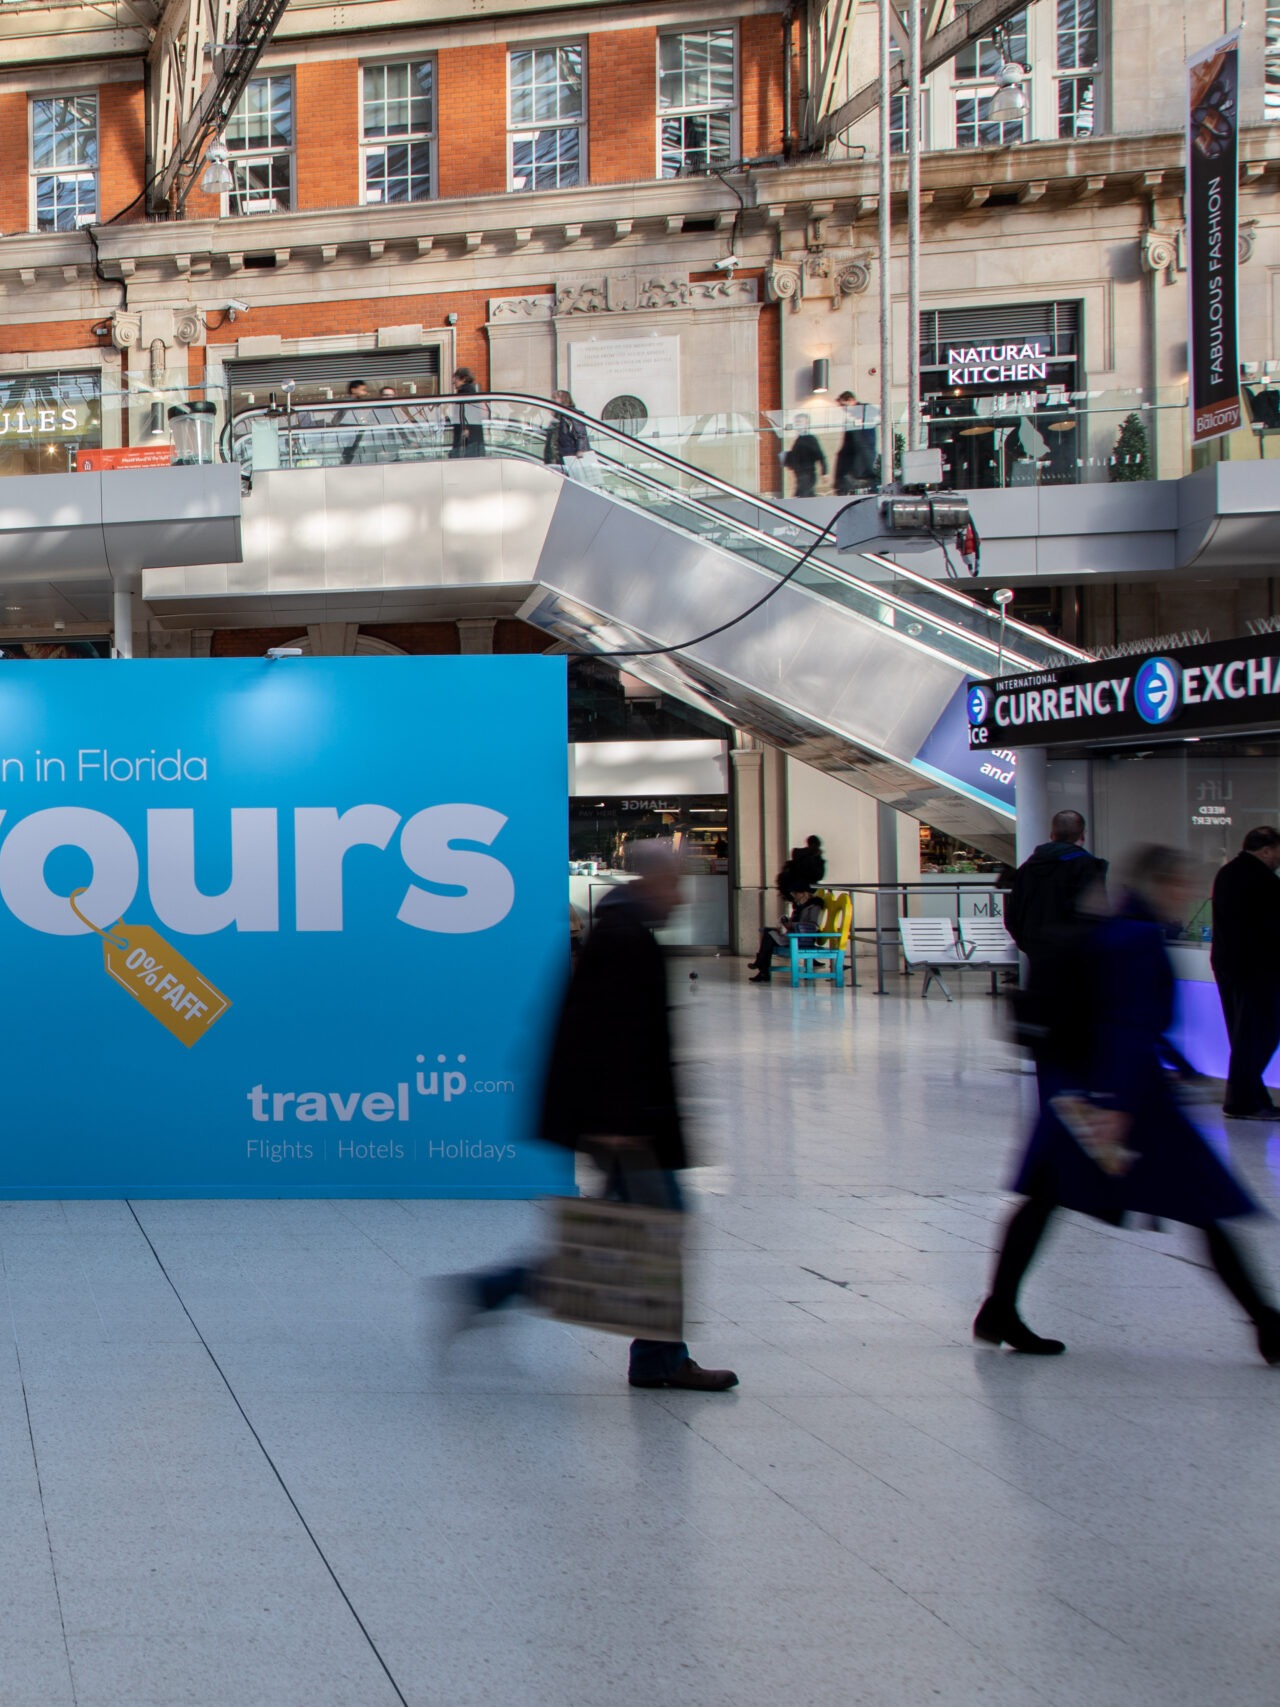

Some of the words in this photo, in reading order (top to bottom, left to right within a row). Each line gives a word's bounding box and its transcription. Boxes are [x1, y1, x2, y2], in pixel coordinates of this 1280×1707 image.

[1207, 176, 1222, 272] FASHION
[1209, 276, 1223, 385] FABULOUS
[948, 343, 1046, 364] NATURAL
[948, 363, 1046, 385] KITCHEN
[1196, 408, 1239, 432] Balcony
[996, 674, 1057, 692] INTERNATIONAL
[994, 677, 1131, 727] CURRENCY
[967, 722, 989, 745] ice
[35, 750, 65, 782] in
[78, 749, 207, 781] Florida
[980, 762, 1014, 785] and
[125, 948, 164, 986] 0%
[153, 972, 209, 1021] FAFF
[247, 1139, 313, 1163] Flights
[338, 1139, 405, 1159] Hotels
[429, 1139, 517, 1163] Holidays
